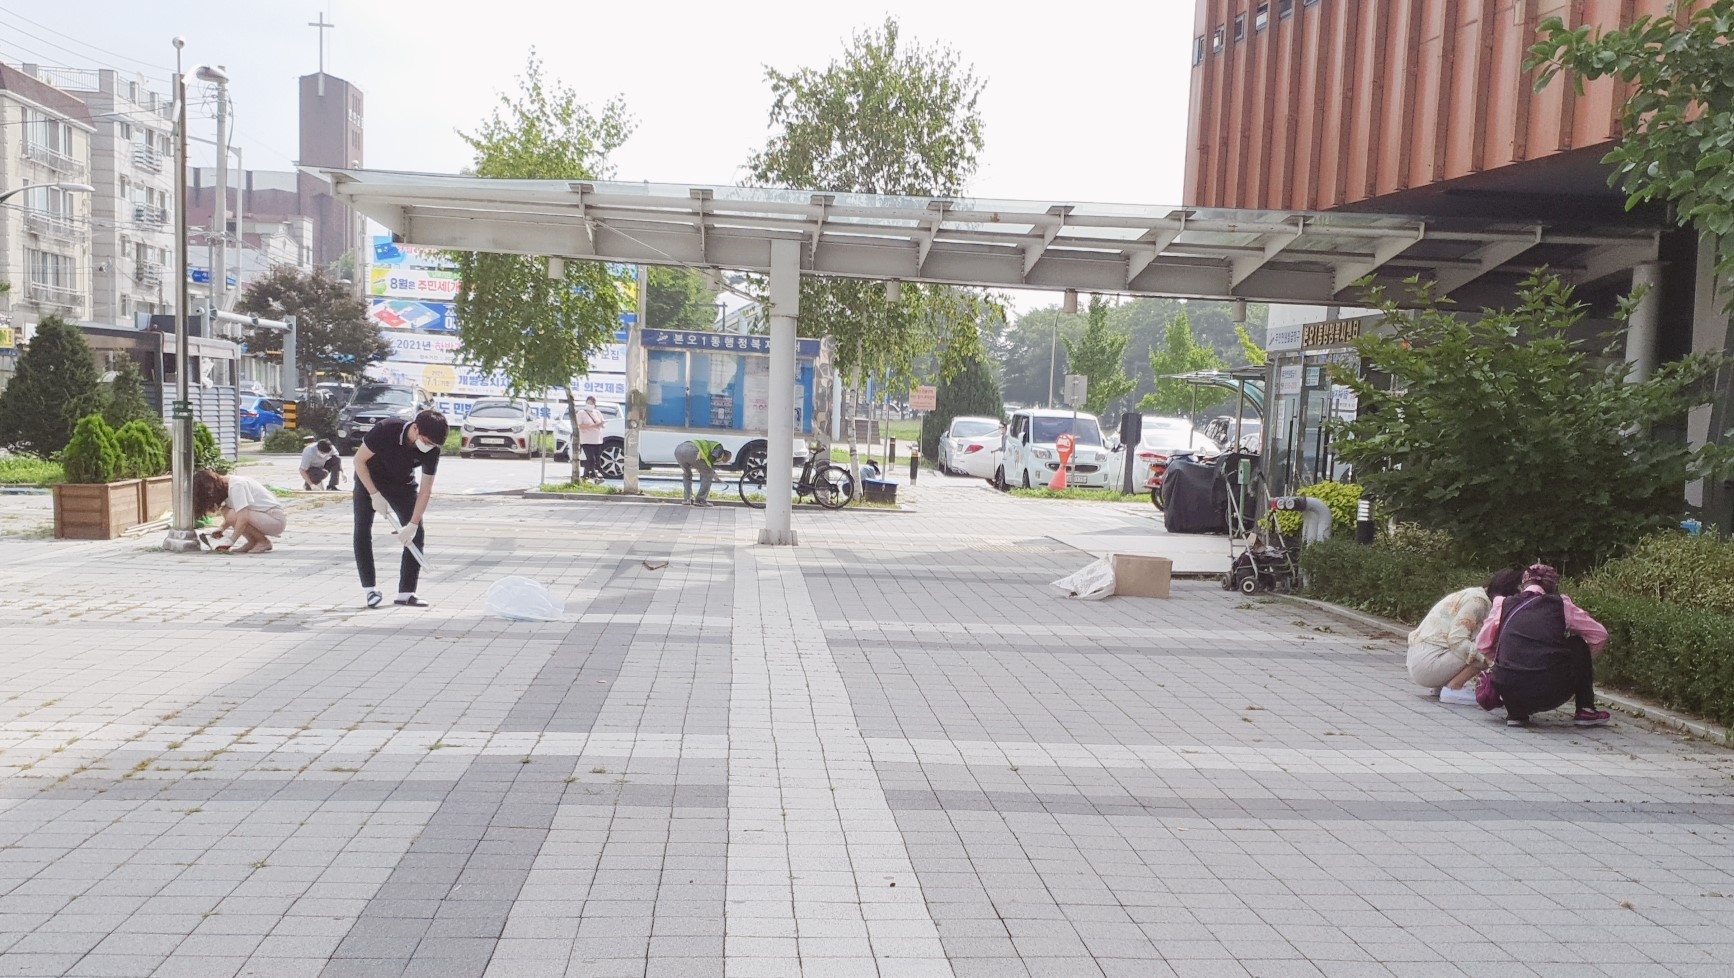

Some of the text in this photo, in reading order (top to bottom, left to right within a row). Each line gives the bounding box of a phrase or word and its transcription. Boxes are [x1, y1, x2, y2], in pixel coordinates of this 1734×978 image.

[390, 277, 416, 291] 8월은
[396, 339, 431, 351] 2021년
[583, 382, 625, 394] 의견제출
